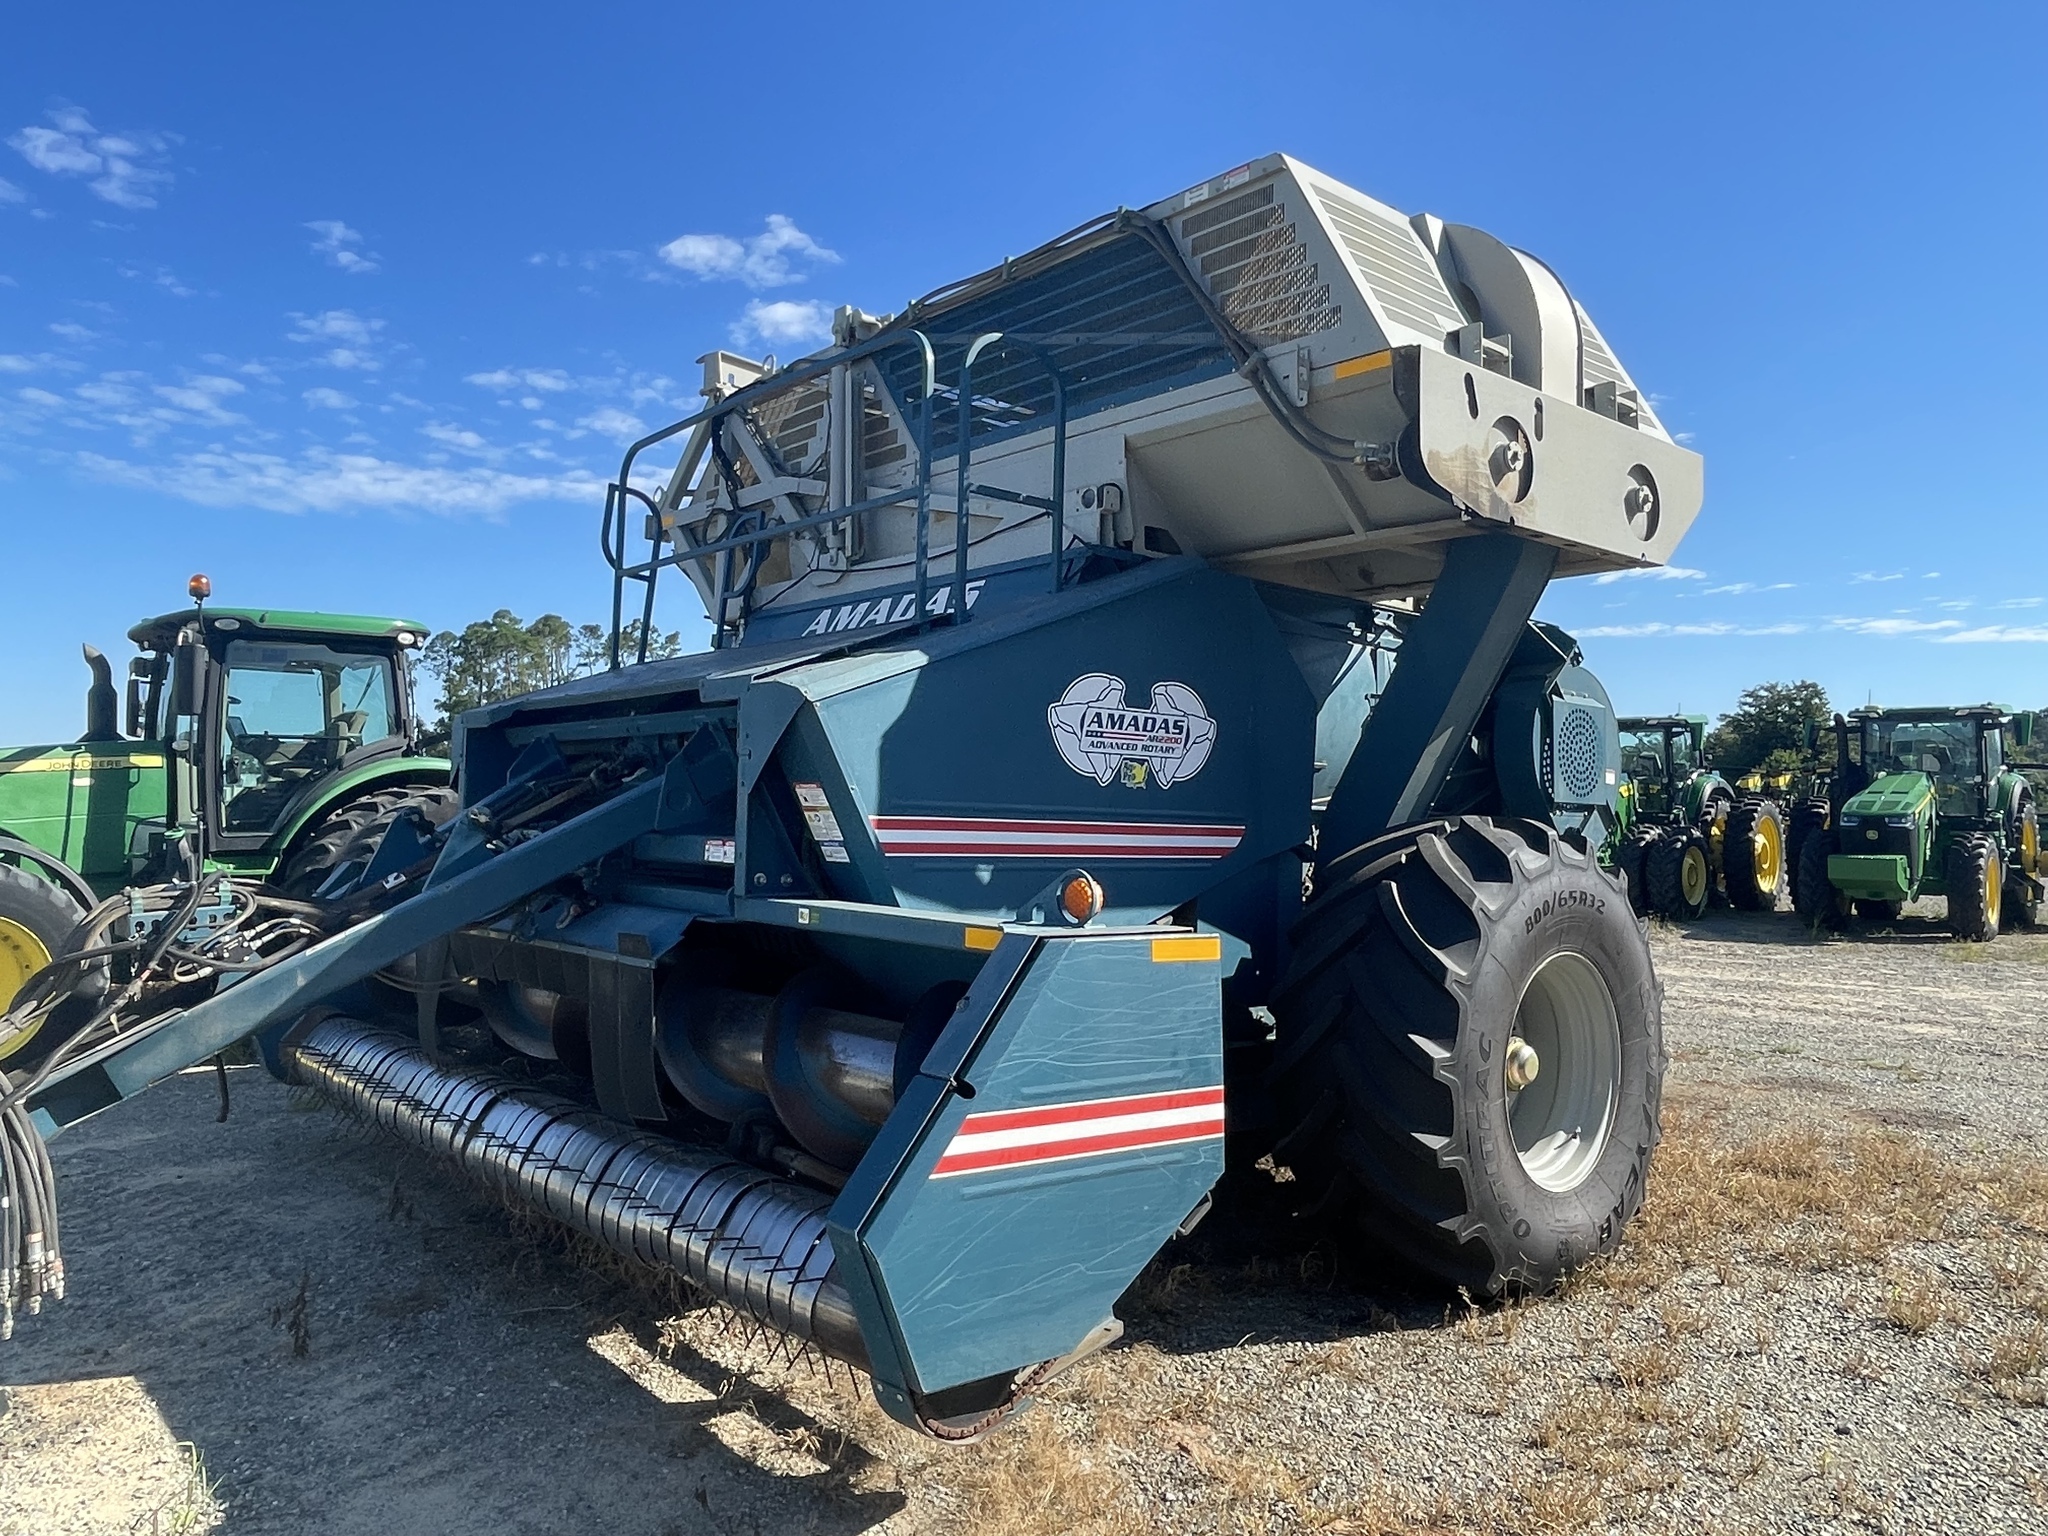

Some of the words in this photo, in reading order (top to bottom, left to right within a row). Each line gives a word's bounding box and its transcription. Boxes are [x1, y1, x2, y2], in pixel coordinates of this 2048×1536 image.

[801, 580, 986, 637] AMADAS
[1087, 712, 1185, 735] AMADAS
[1088, 741, 1138, 751] ADVANCED
[1141, 744, 1176, 754] ROTARY
[1145, 735, 1183, 745] AR2200
[46, 761, 79, 770] JOHN
[82, 760, 122, 768] DEERE
[1525, 889, 1605, 935] 800/65R32
